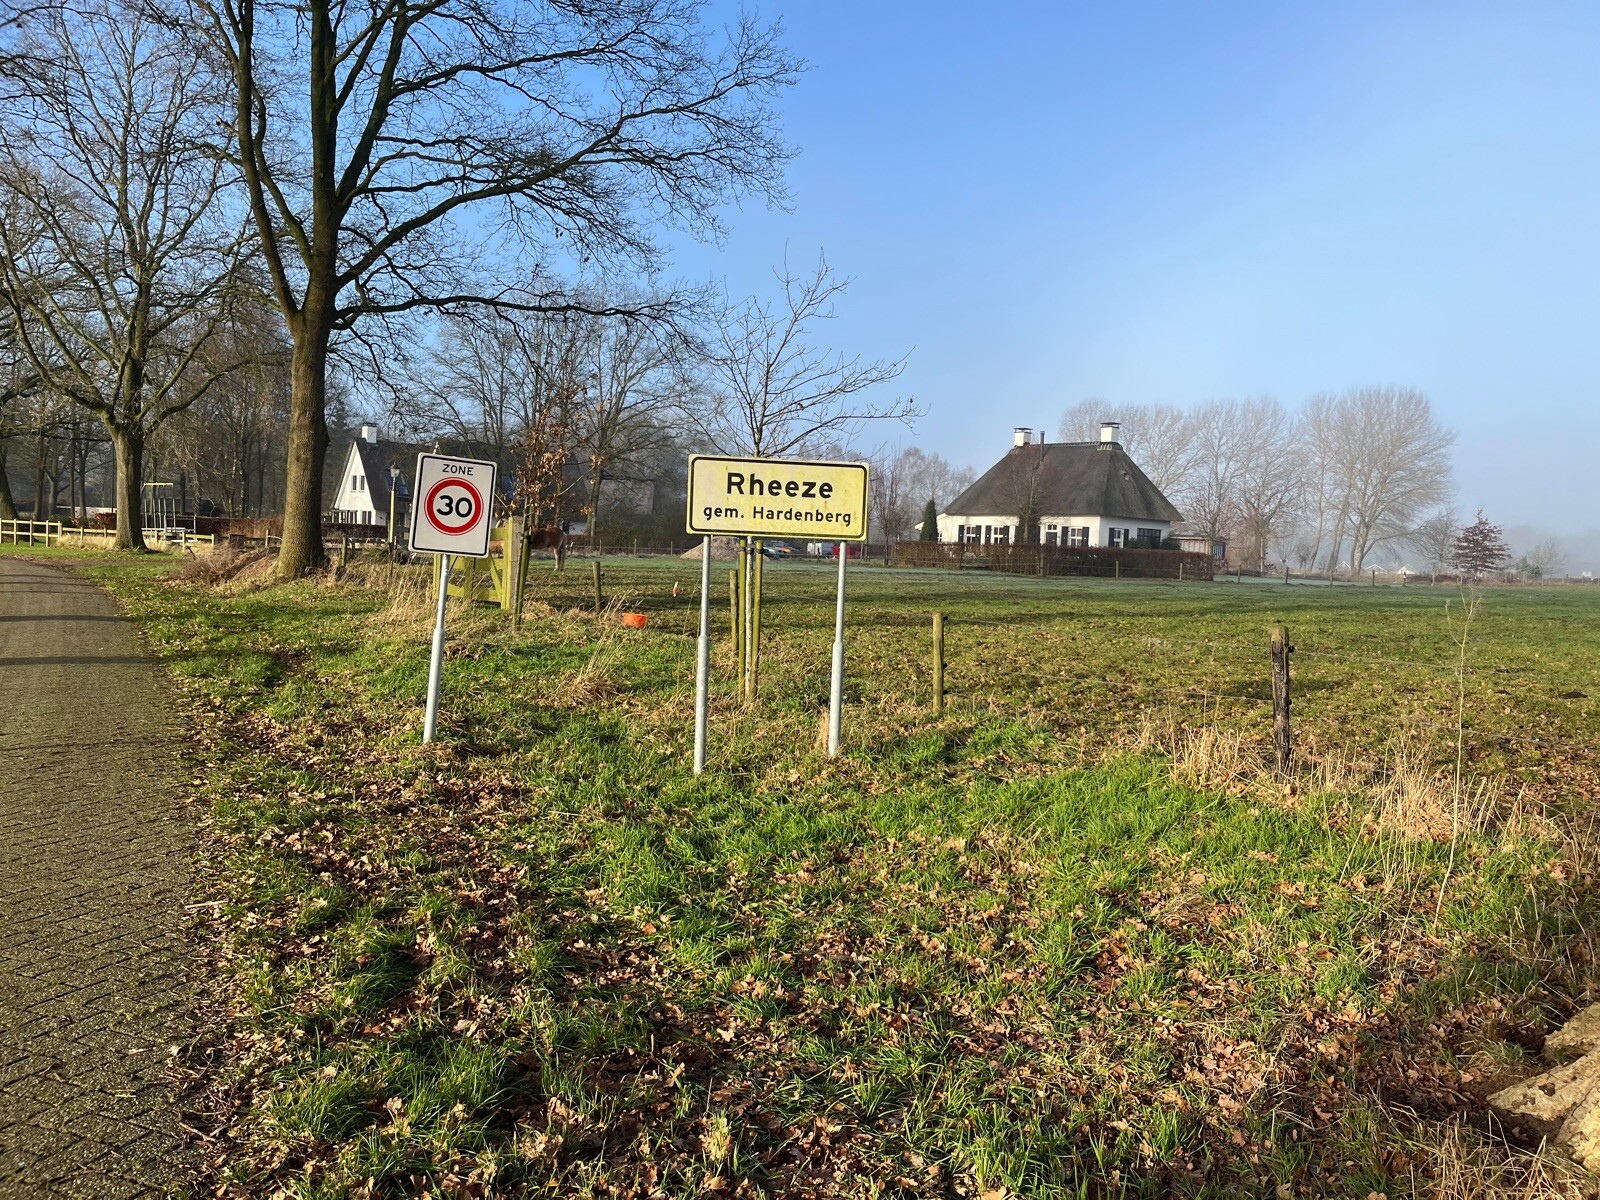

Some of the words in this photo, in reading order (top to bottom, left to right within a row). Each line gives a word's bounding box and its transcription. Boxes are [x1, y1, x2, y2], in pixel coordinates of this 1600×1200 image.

[442, 463, 474, 476] ZONE
[727, 472, 834, 498] Rheeze
[436, 495, 473, 518] 30
[703, 506, 745, 521] gem.
[753, 506, 852, 527] Hardenberg
